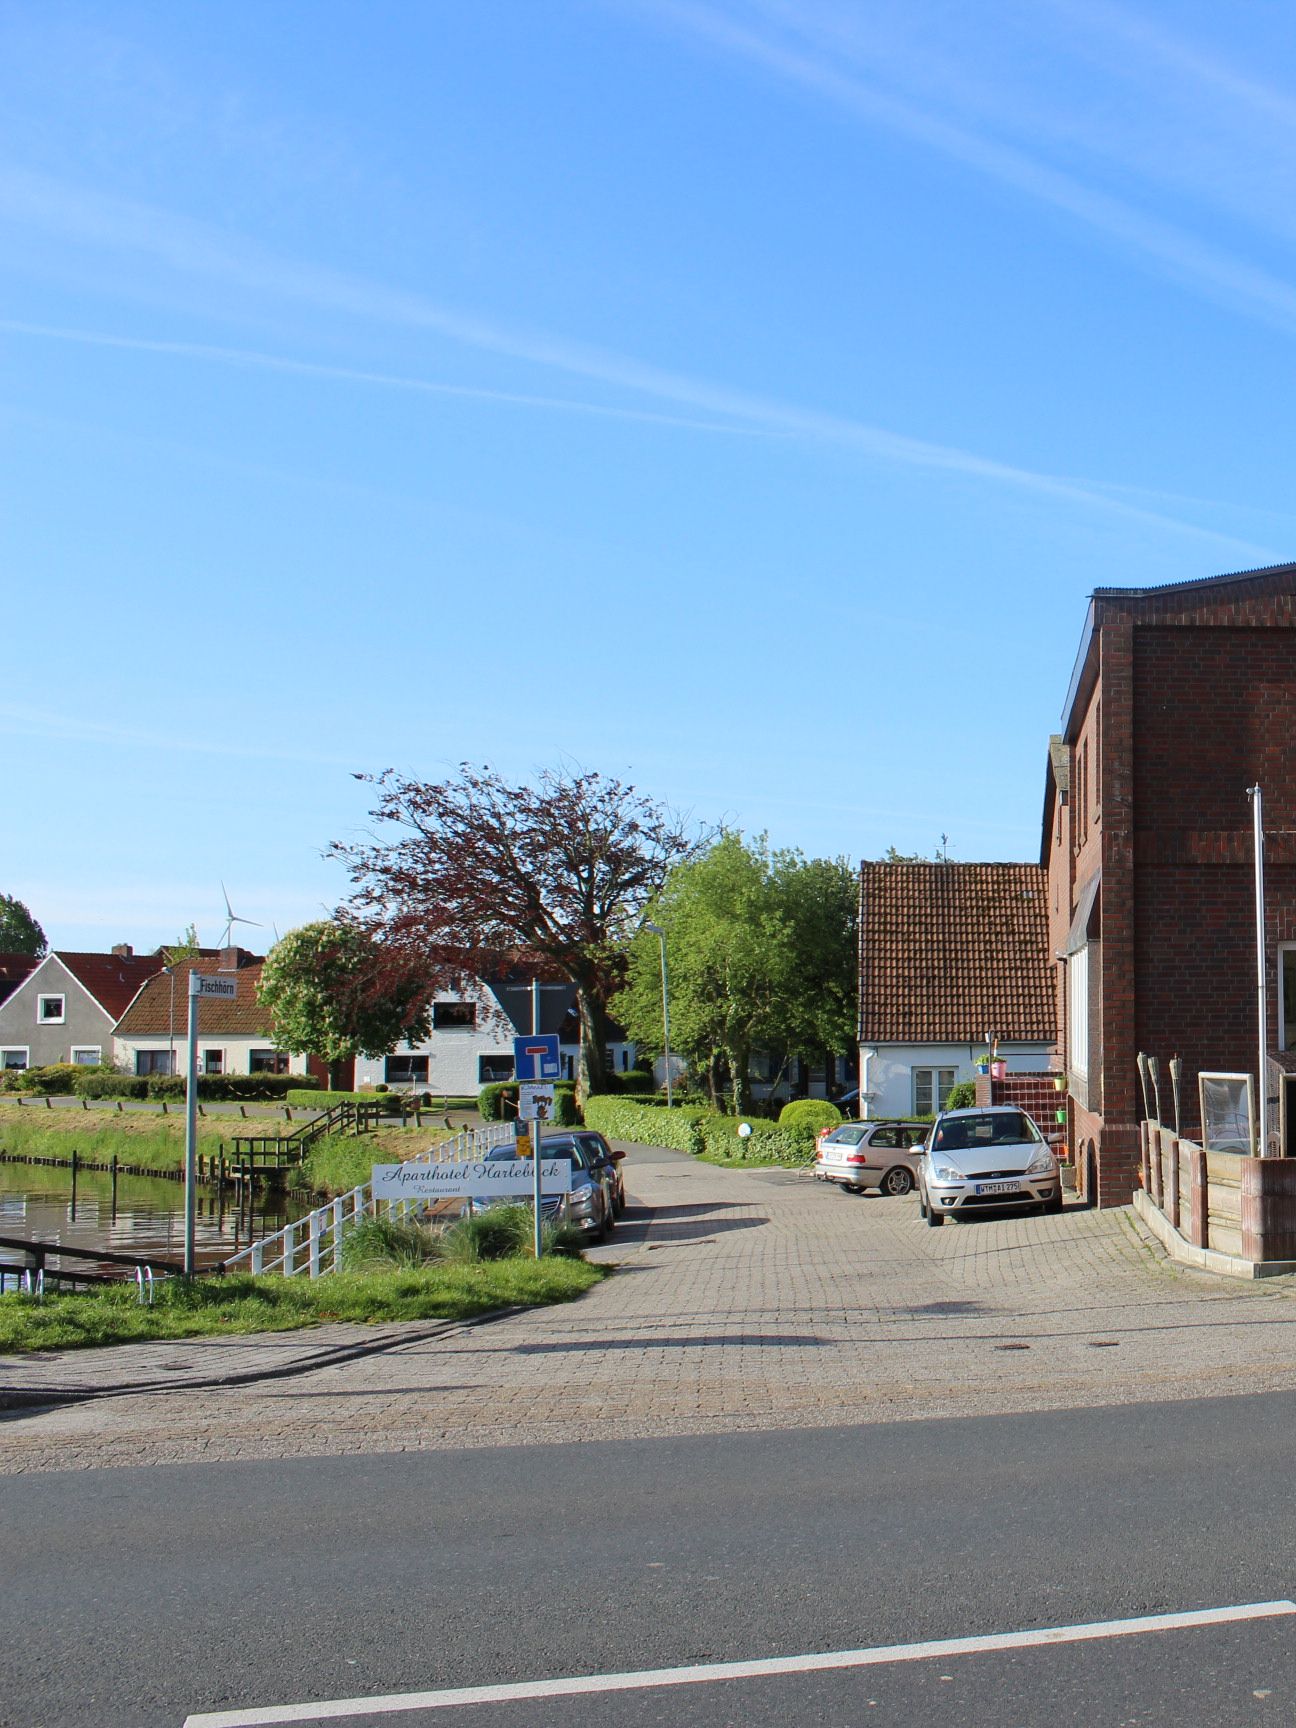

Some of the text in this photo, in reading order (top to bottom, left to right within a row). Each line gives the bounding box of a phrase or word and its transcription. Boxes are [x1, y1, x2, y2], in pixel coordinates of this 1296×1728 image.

[200, 979, 234, 994] Fischhörn
[382, 1161, 560, 1186] Aparthotel Harleblck
[414, 1185, 460, 1193] Restaurant
